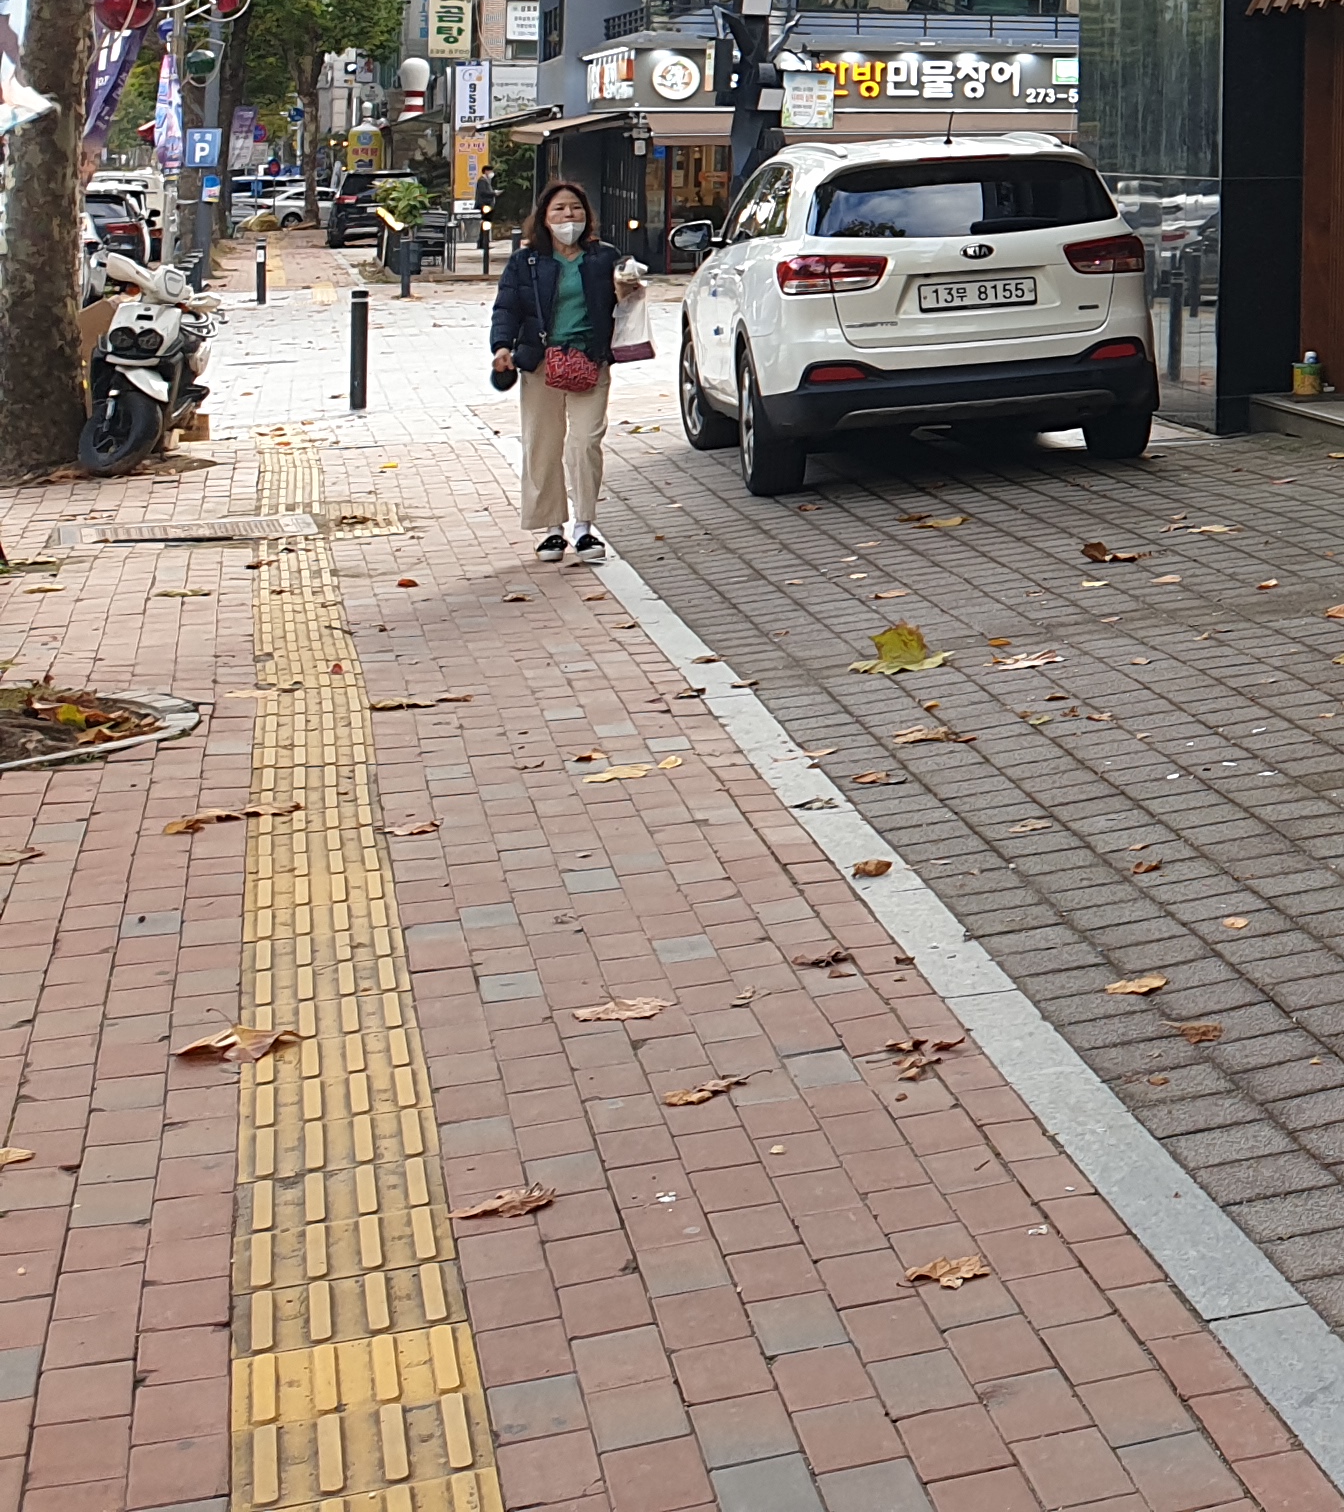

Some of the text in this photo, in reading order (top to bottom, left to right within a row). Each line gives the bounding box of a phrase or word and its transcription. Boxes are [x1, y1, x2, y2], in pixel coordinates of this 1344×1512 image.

[194, 142, 210, 164] P
[966, 246, 989, 257] KIA
[931, 282, 1025, 305] 13무 8155
